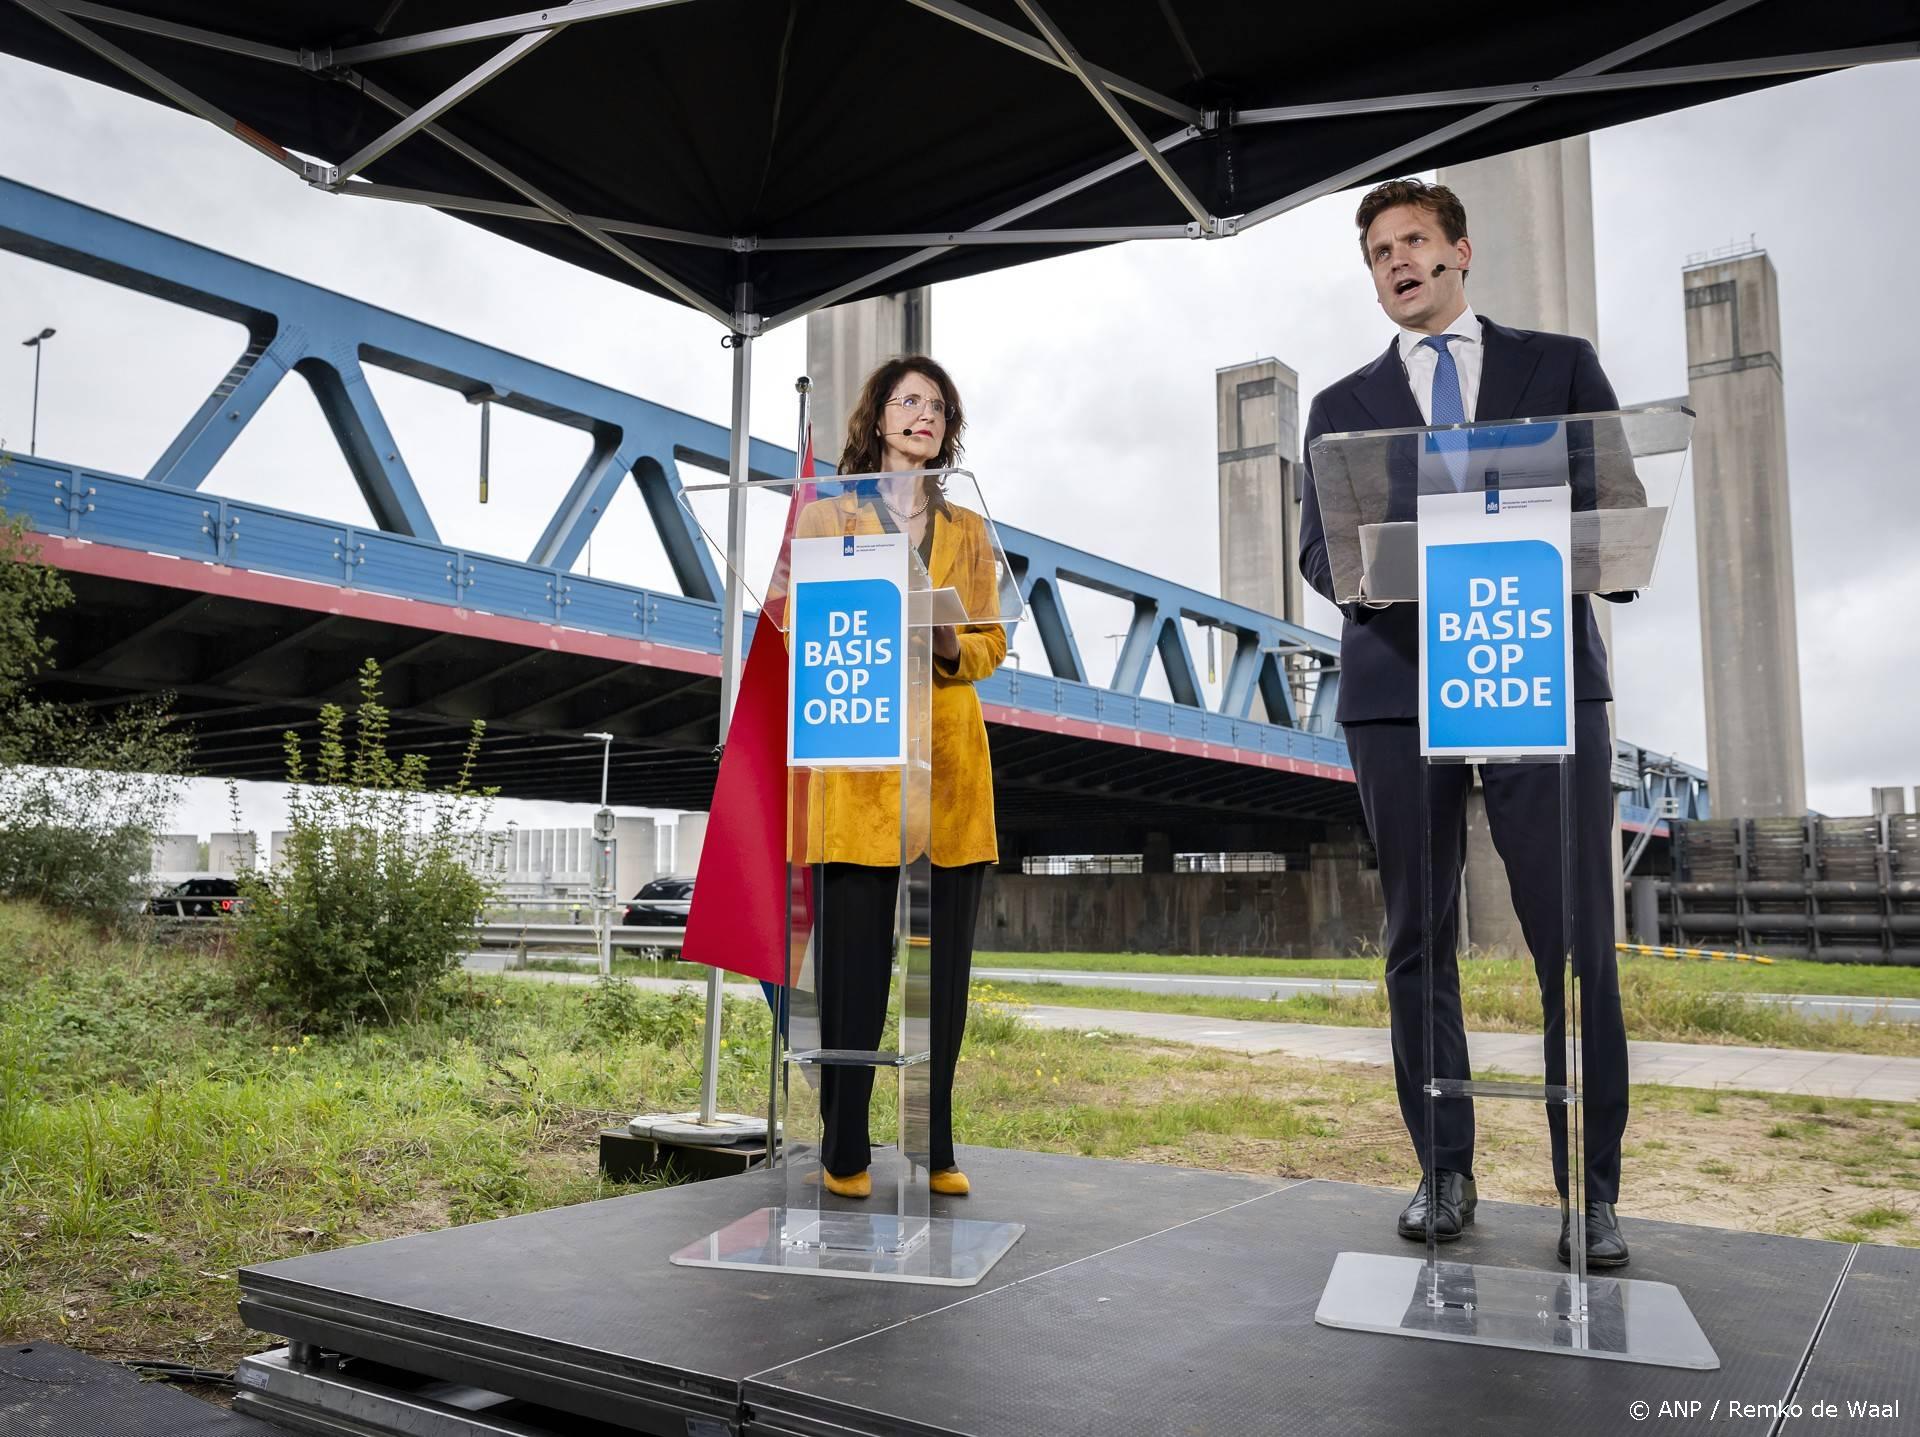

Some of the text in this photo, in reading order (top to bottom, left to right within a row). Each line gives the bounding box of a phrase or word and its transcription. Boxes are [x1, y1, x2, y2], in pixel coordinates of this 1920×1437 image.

[1469, 576, 1520, 608] DE
[829, 610, 868, 637] DE
[1439, 608, 1553, 642] BASIS
[804, 638, 892, 667] BASIS
[1467, 643, 1524, 675] OP
[825, 668, 870, 696] OP
[1440, 676, 1552, 709] ORDE
[803, 696, 890, 725] ORDE
